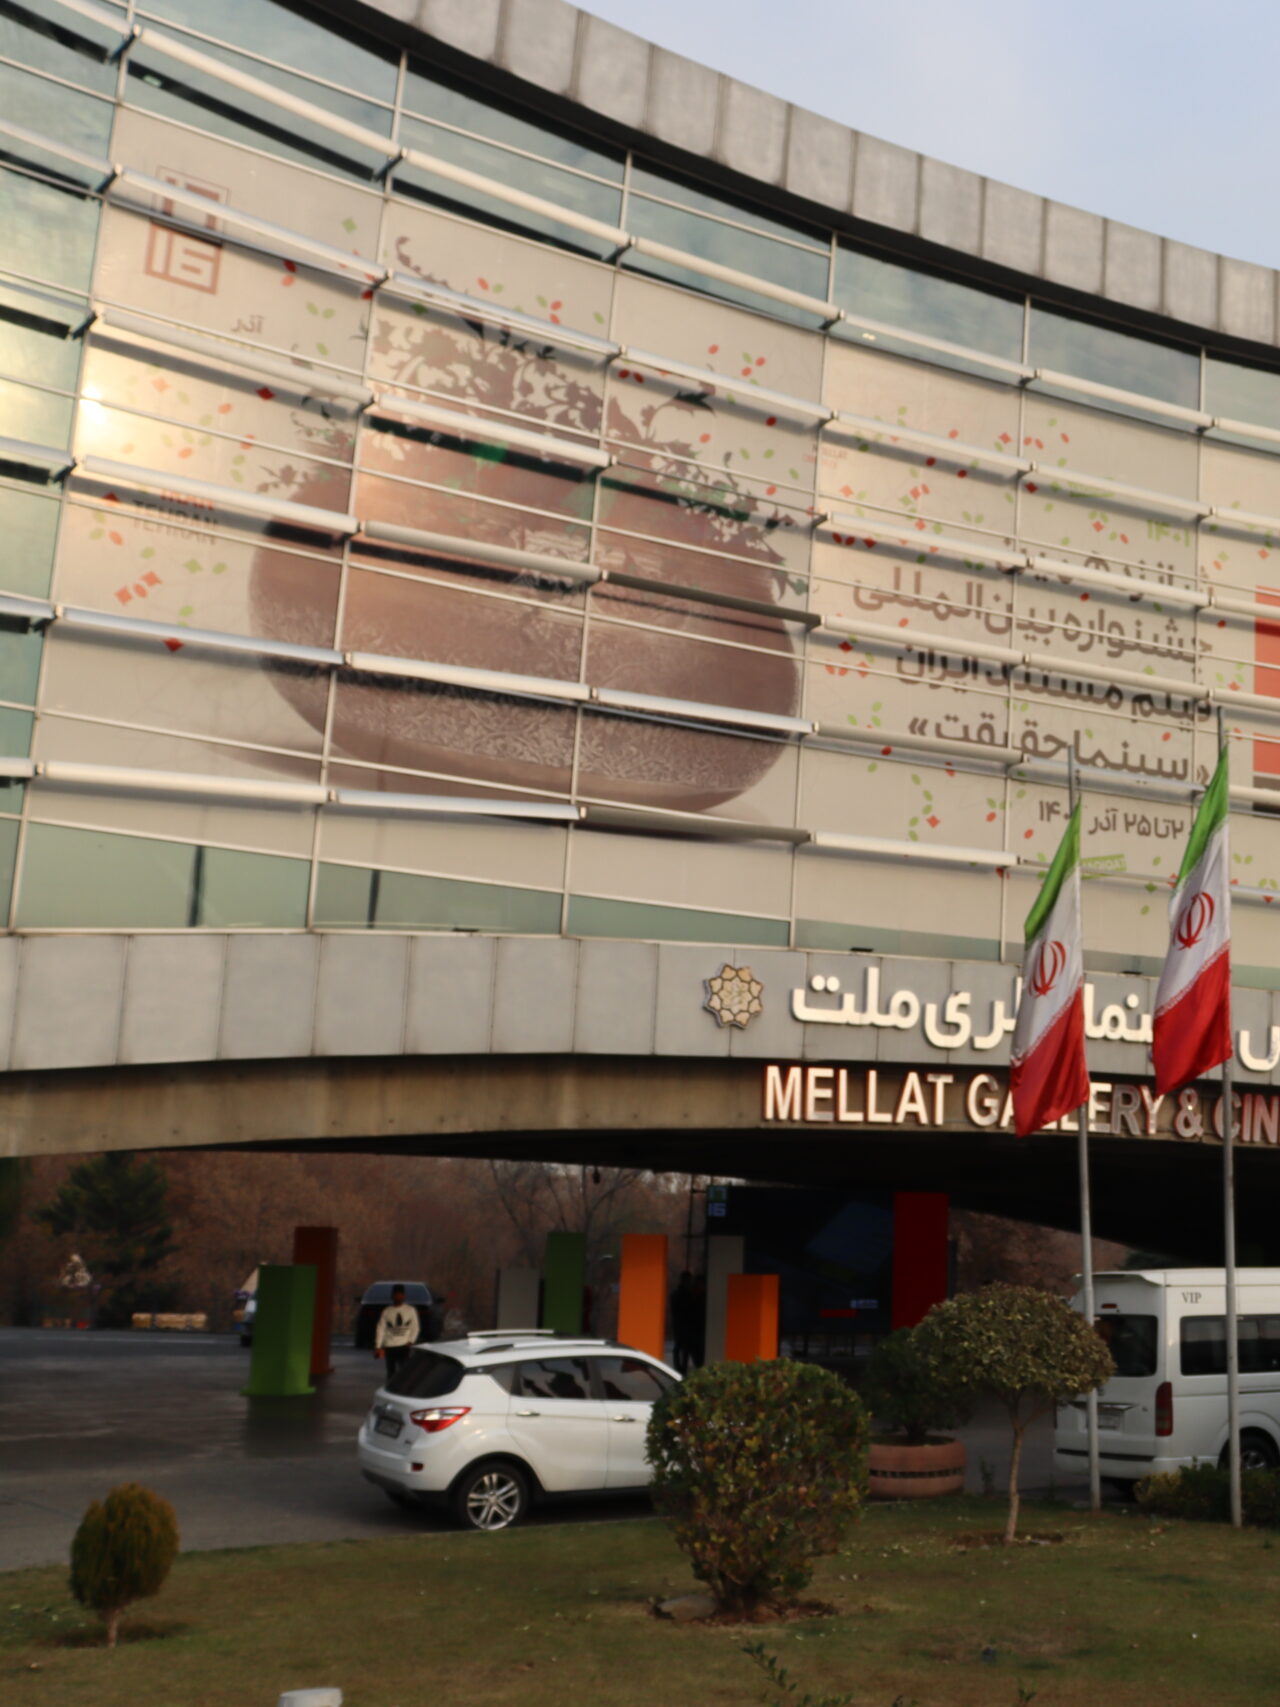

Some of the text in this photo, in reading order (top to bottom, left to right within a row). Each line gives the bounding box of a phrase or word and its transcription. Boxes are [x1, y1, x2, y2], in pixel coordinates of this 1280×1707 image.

[1039, 800, 1072, 822] ۱۴۰
[1088, 808, 1119, 835] آذر
[791, 966, 921, 1030] ملت
[764, 1065, 954, 1125] MELLAT
[1173, 1086, 1204, 1138] &
[1181, 1290, 1202, 1305] VIP
